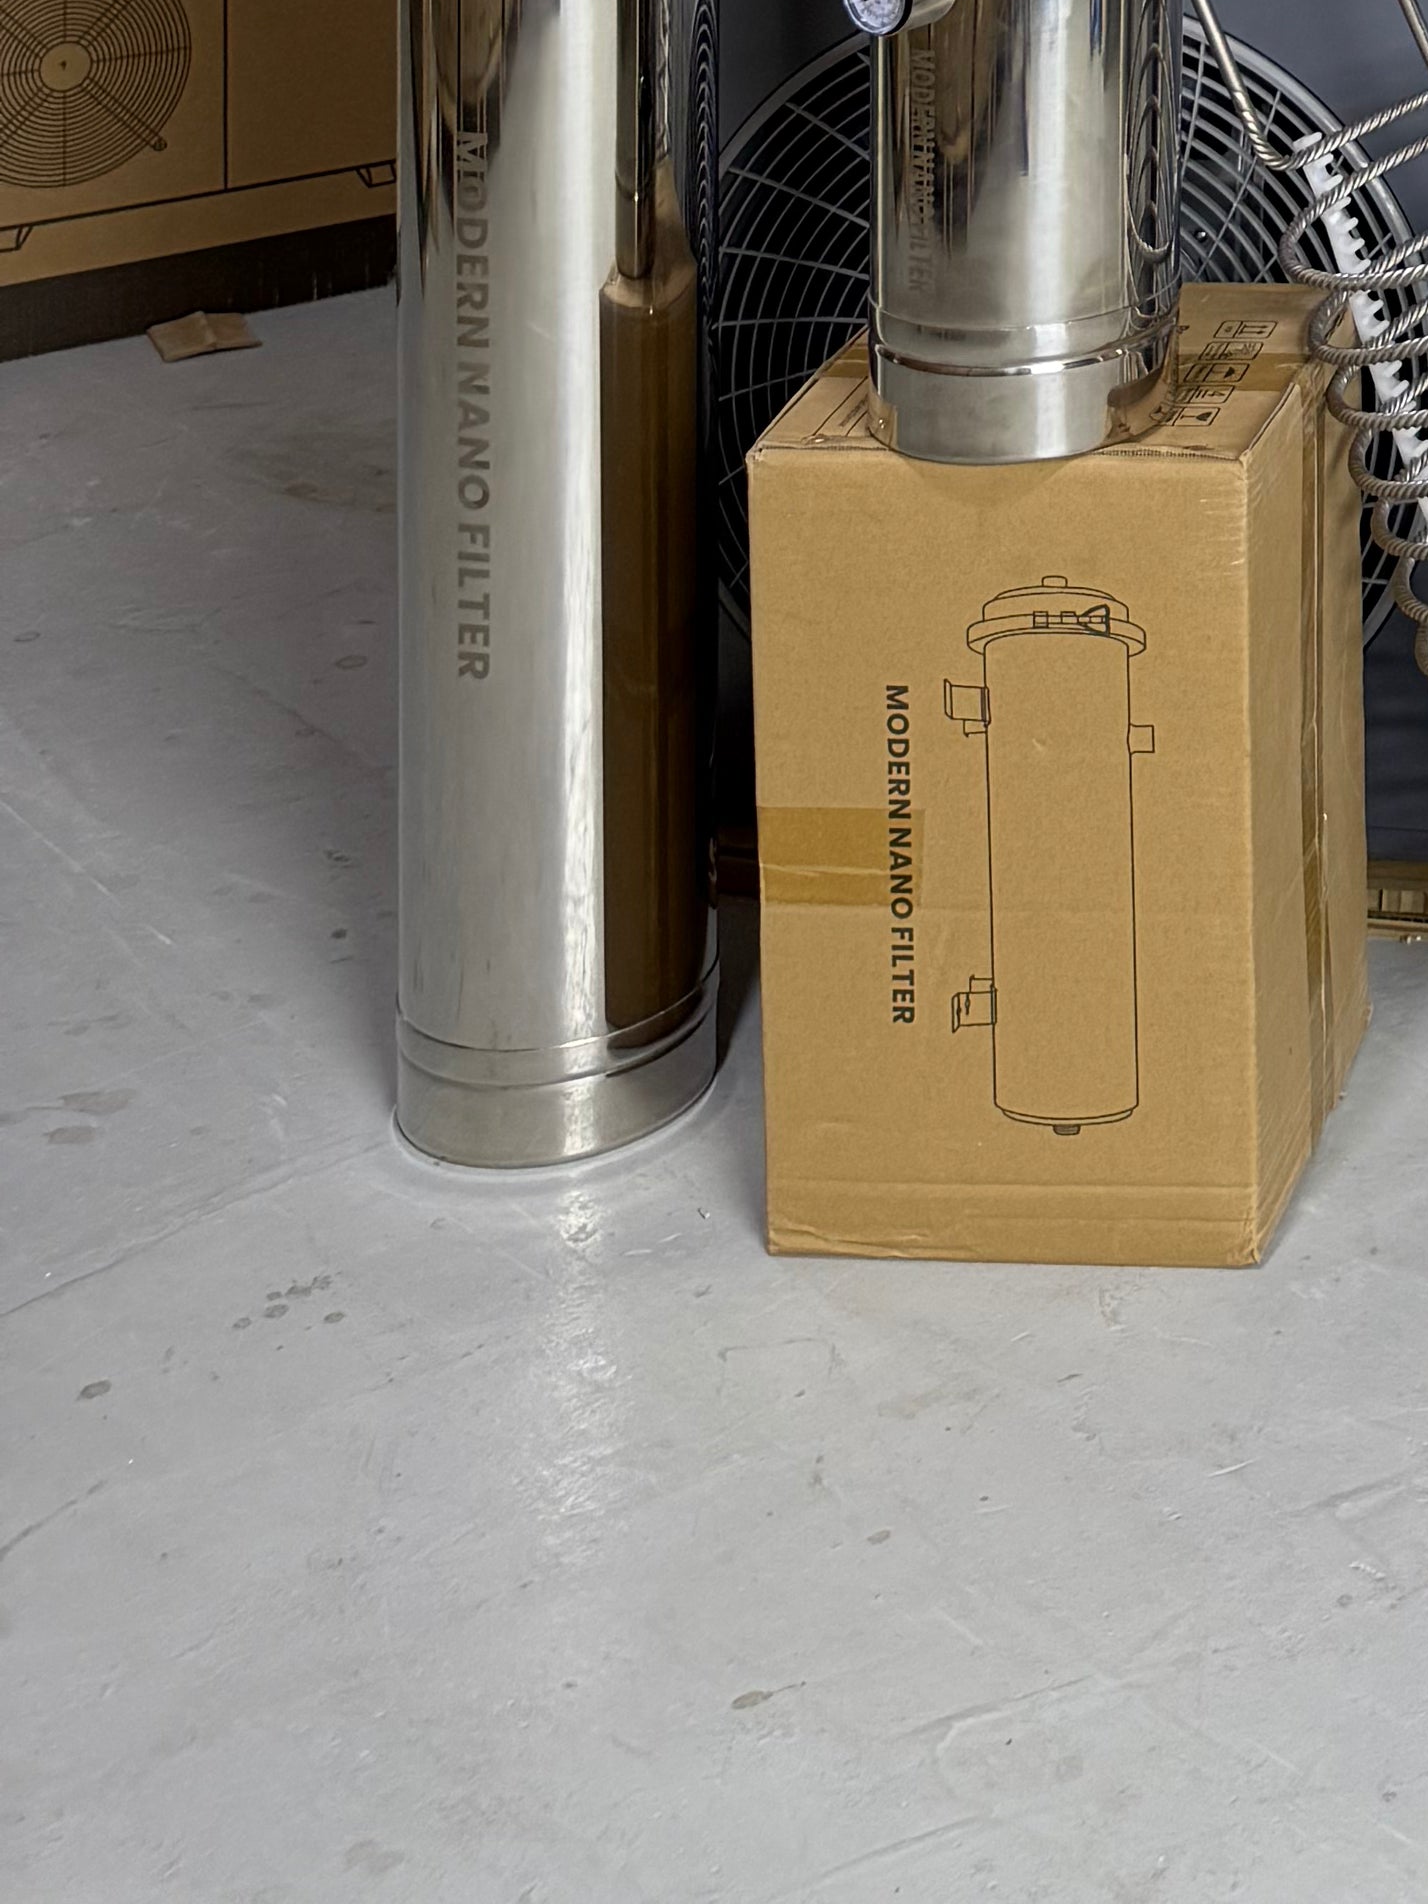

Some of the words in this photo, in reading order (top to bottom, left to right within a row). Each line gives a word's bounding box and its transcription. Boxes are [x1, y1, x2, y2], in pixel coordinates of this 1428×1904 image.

[456, 131, 490, 348] MODERN
[456, 362, 491, 512] NANO
[456, 523, 491, 681] FILTER
[886, 685, 912, 820] MODERN
[888, 827, 913, 920] NANO
[891, 927, 916, 1025] FILTER
